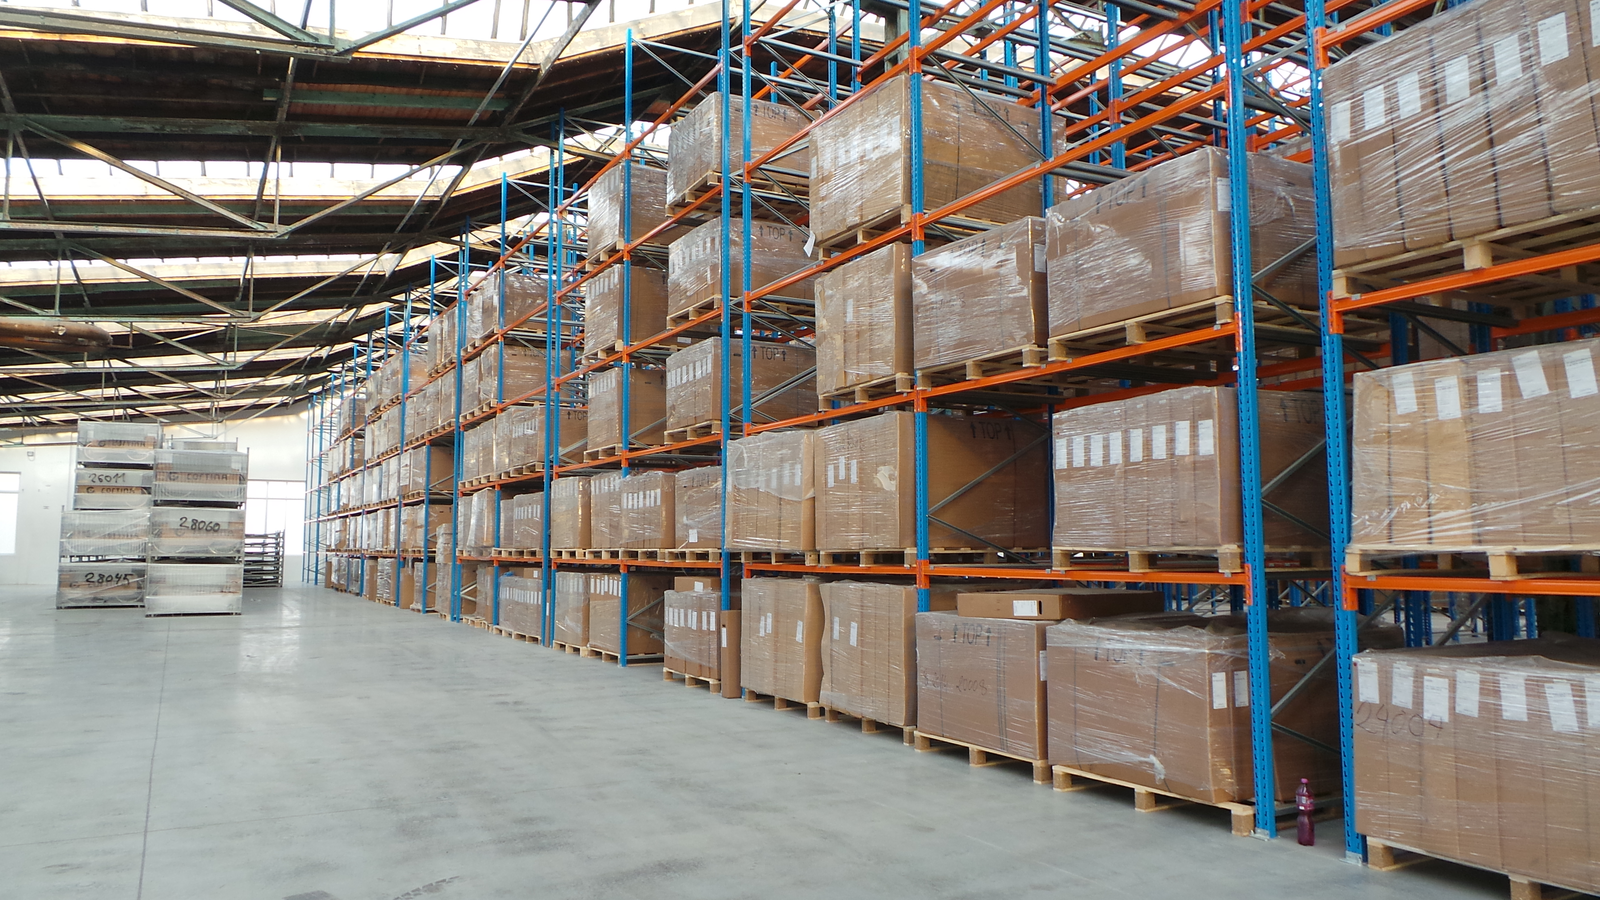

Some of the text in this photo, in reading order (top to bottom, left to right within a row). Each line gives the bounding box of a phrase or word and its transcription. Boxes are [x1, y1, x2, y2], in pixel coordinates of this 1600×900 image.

[1108, 178, 1136, 210] TOP
[767, 225, 786, 240] TOP
[760, 346, 779, 361] TOP
[978, 421, 1003, 440] TOP
[179, 516, 221, 532] 28060
[84, 572, 134, 585] 28045
[962, 622, 983, 645] TOP
